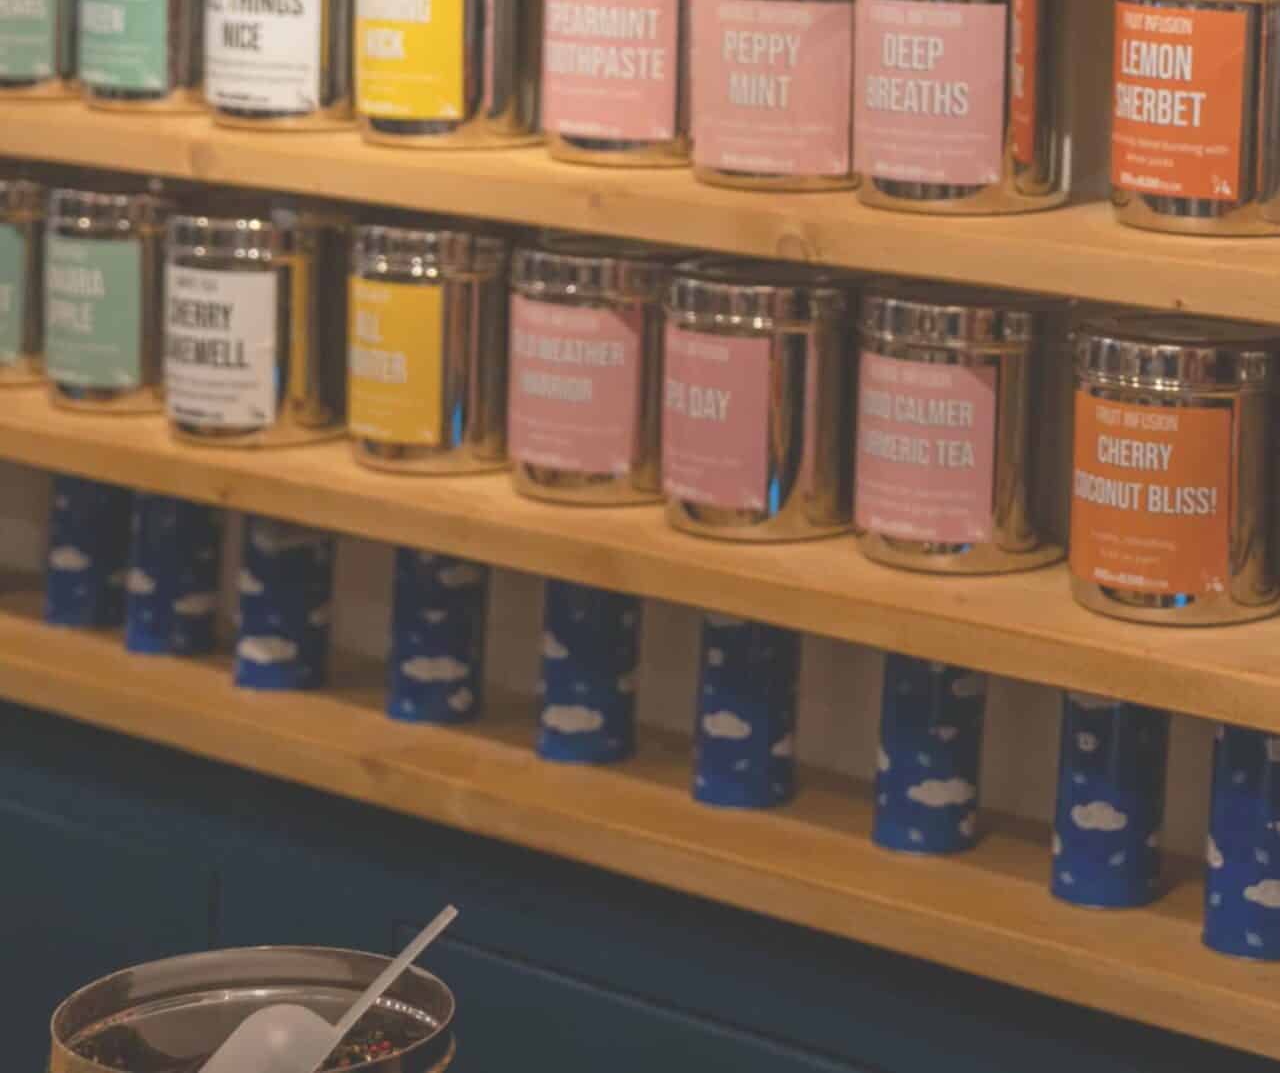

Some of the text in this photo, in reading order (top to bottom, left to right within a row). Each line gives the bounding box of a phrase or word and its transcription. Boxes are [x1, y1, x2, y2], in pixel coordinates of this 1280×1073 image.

[222, 22, 261, 51] NICE
[721, 30, 800, 68] PEPPY
[881, 31, 944, 71] DEEP
[1121, 38, 1193, 81] LEMON
[728, 71, 792, 109] MINT
[865, 75, 970, 116] BREATHS
[936, 439, 975, 467] TEA
[1097, 435, 1173, 471] CHERRY
[1148, 484, 1217, 515] BLISS!
